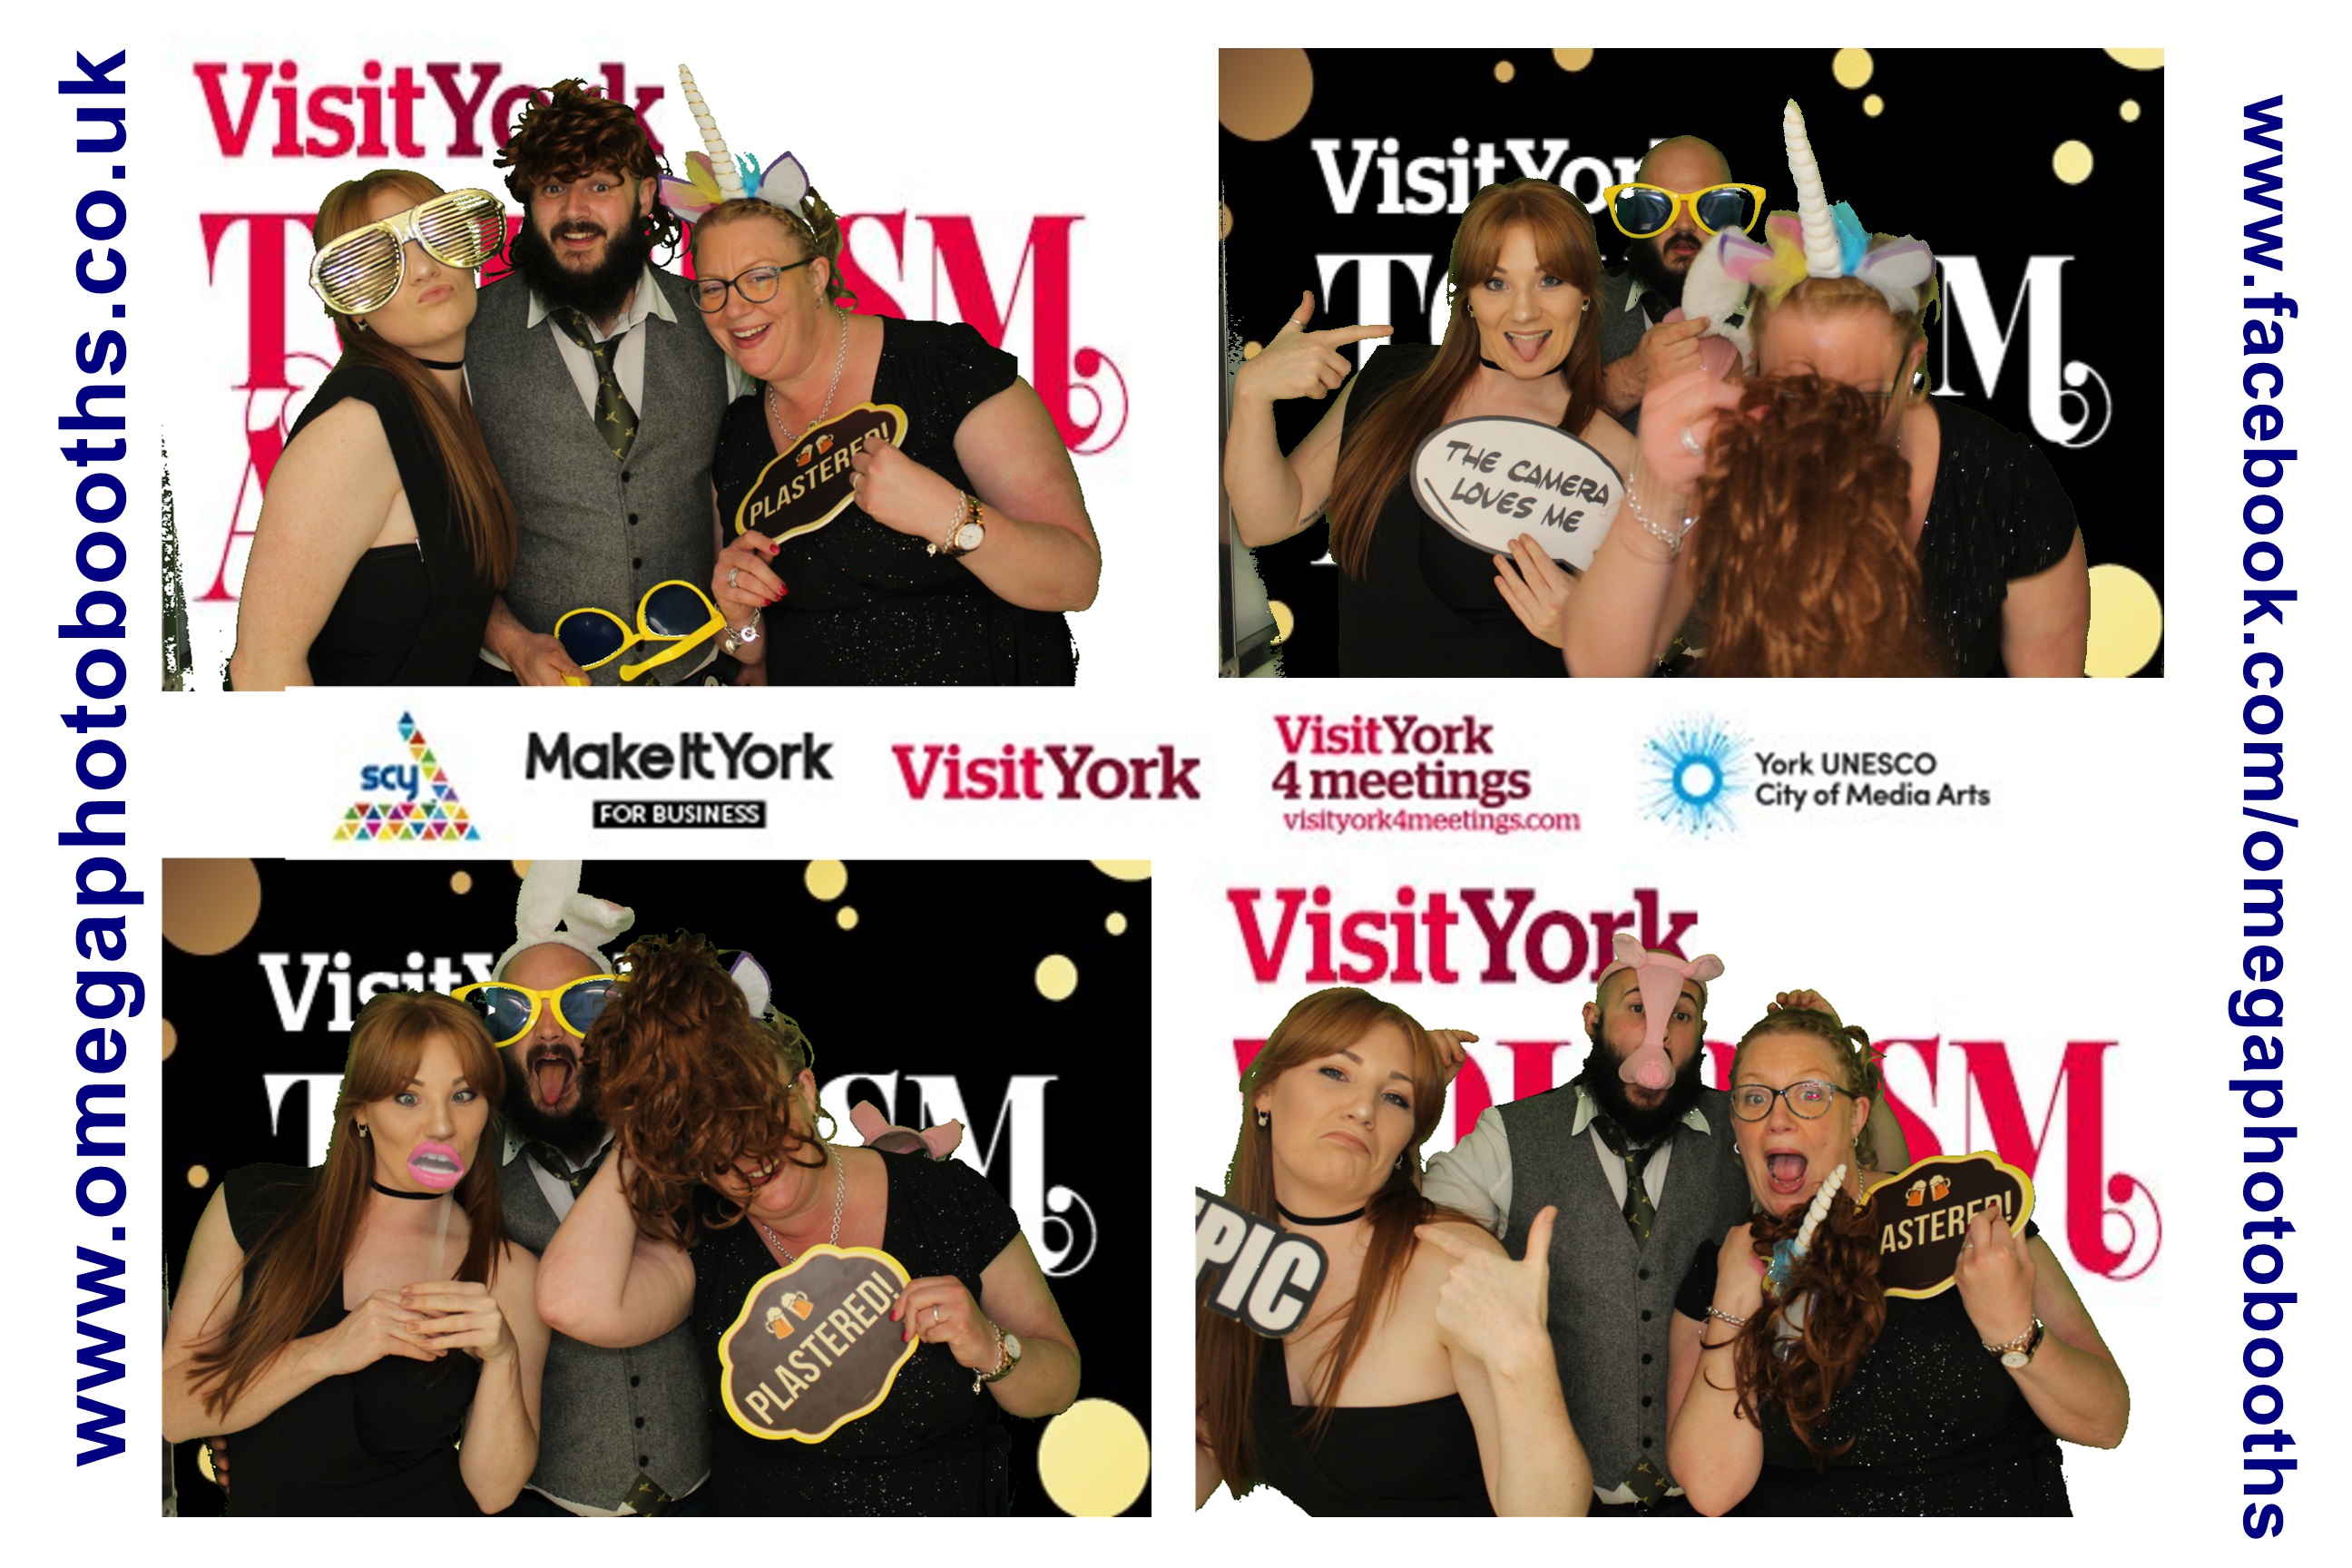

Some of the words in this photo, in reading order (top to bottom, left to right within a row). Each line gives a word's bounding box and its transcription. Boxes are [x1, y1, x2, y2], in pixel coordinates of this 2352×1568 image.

[1446, 440, 1502, 474] THE
[1507, 460, 1610, 507] CAMERA
[1450, 477, 1537, 519] LOVES
[1541, 504, 1584, 533] ME
[1196, 1195, 1321, 1330] PIC
[744, 1270, 900, 1426] PLASTERED!
